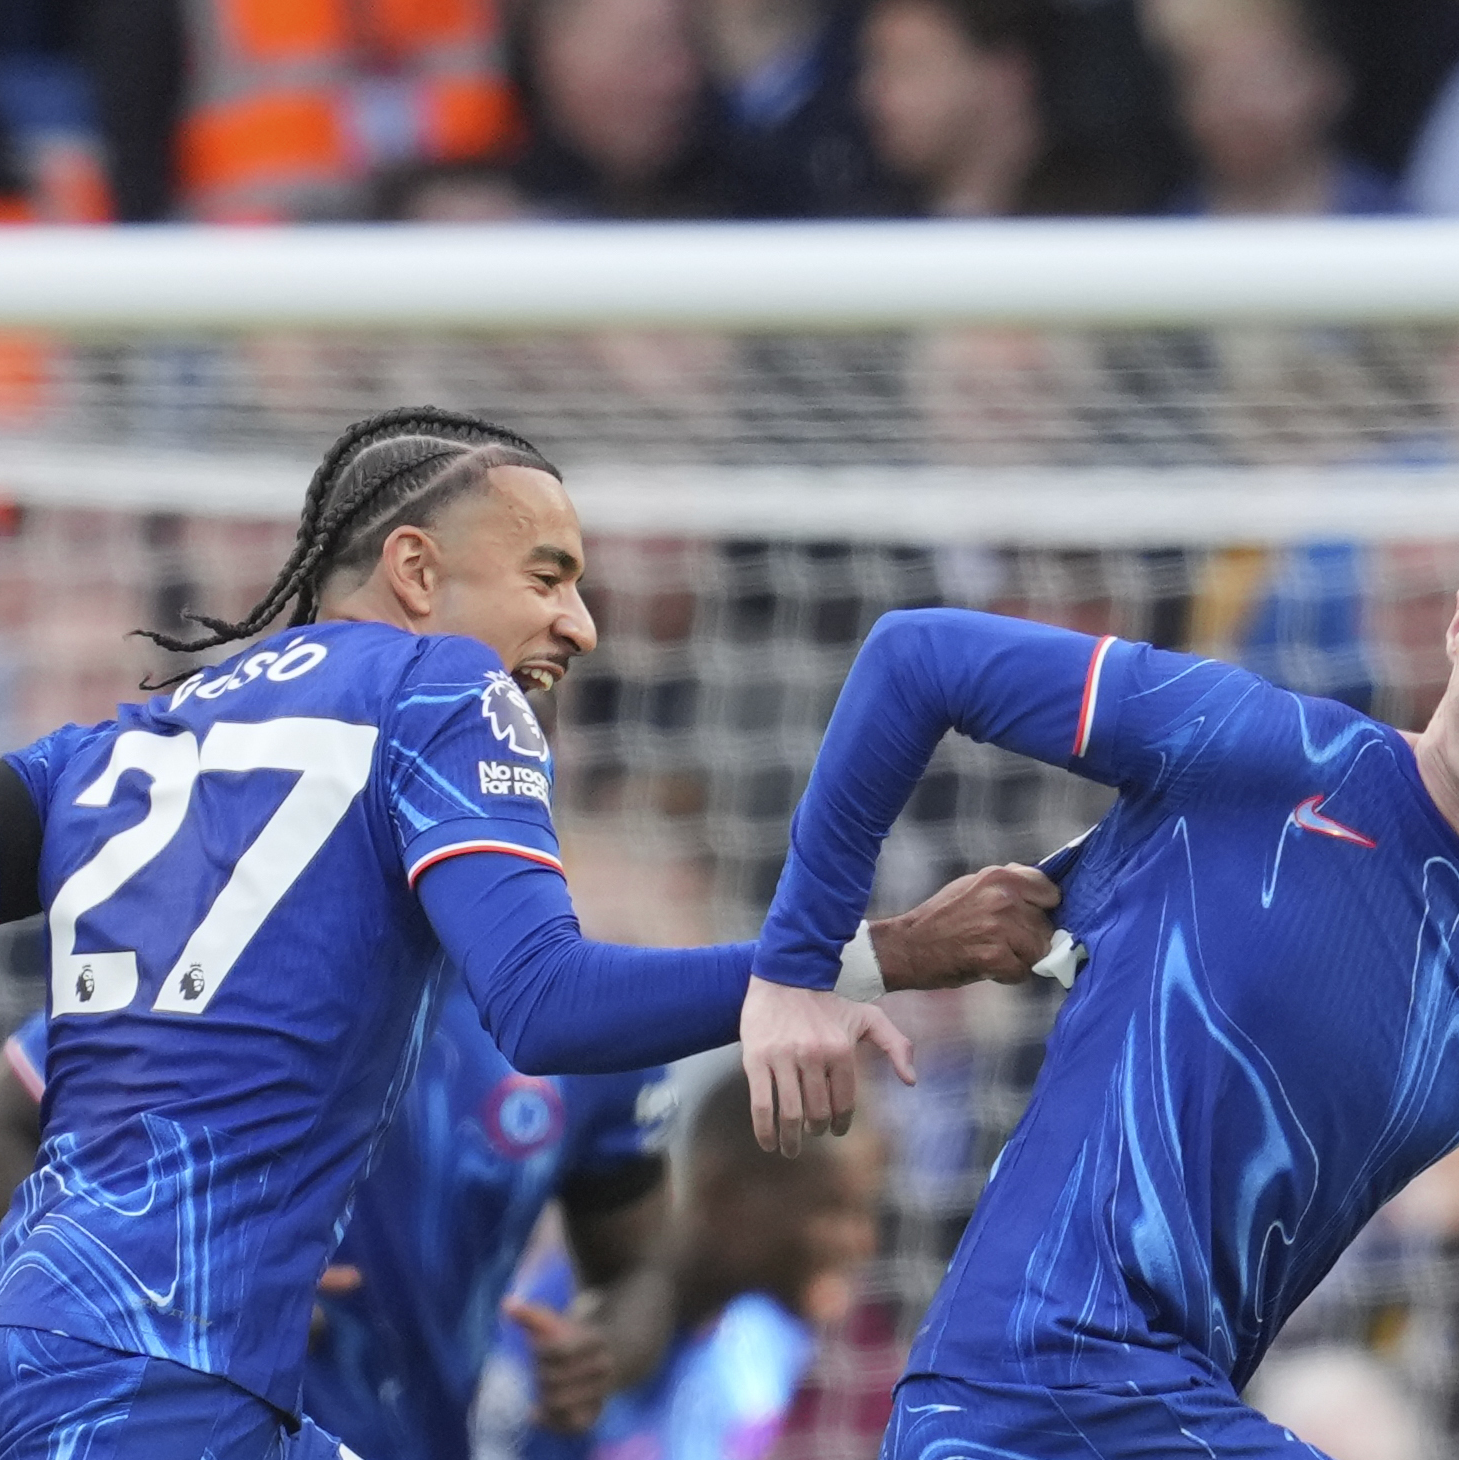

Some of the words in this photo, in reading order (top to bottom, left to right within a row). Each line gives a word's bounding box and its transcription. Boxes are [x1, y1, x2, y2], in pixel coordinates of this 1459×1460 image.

[478, 761, 511, 780] No
[513, 766, 548, 790] roo
[50, 716, 380, 1020] 27
